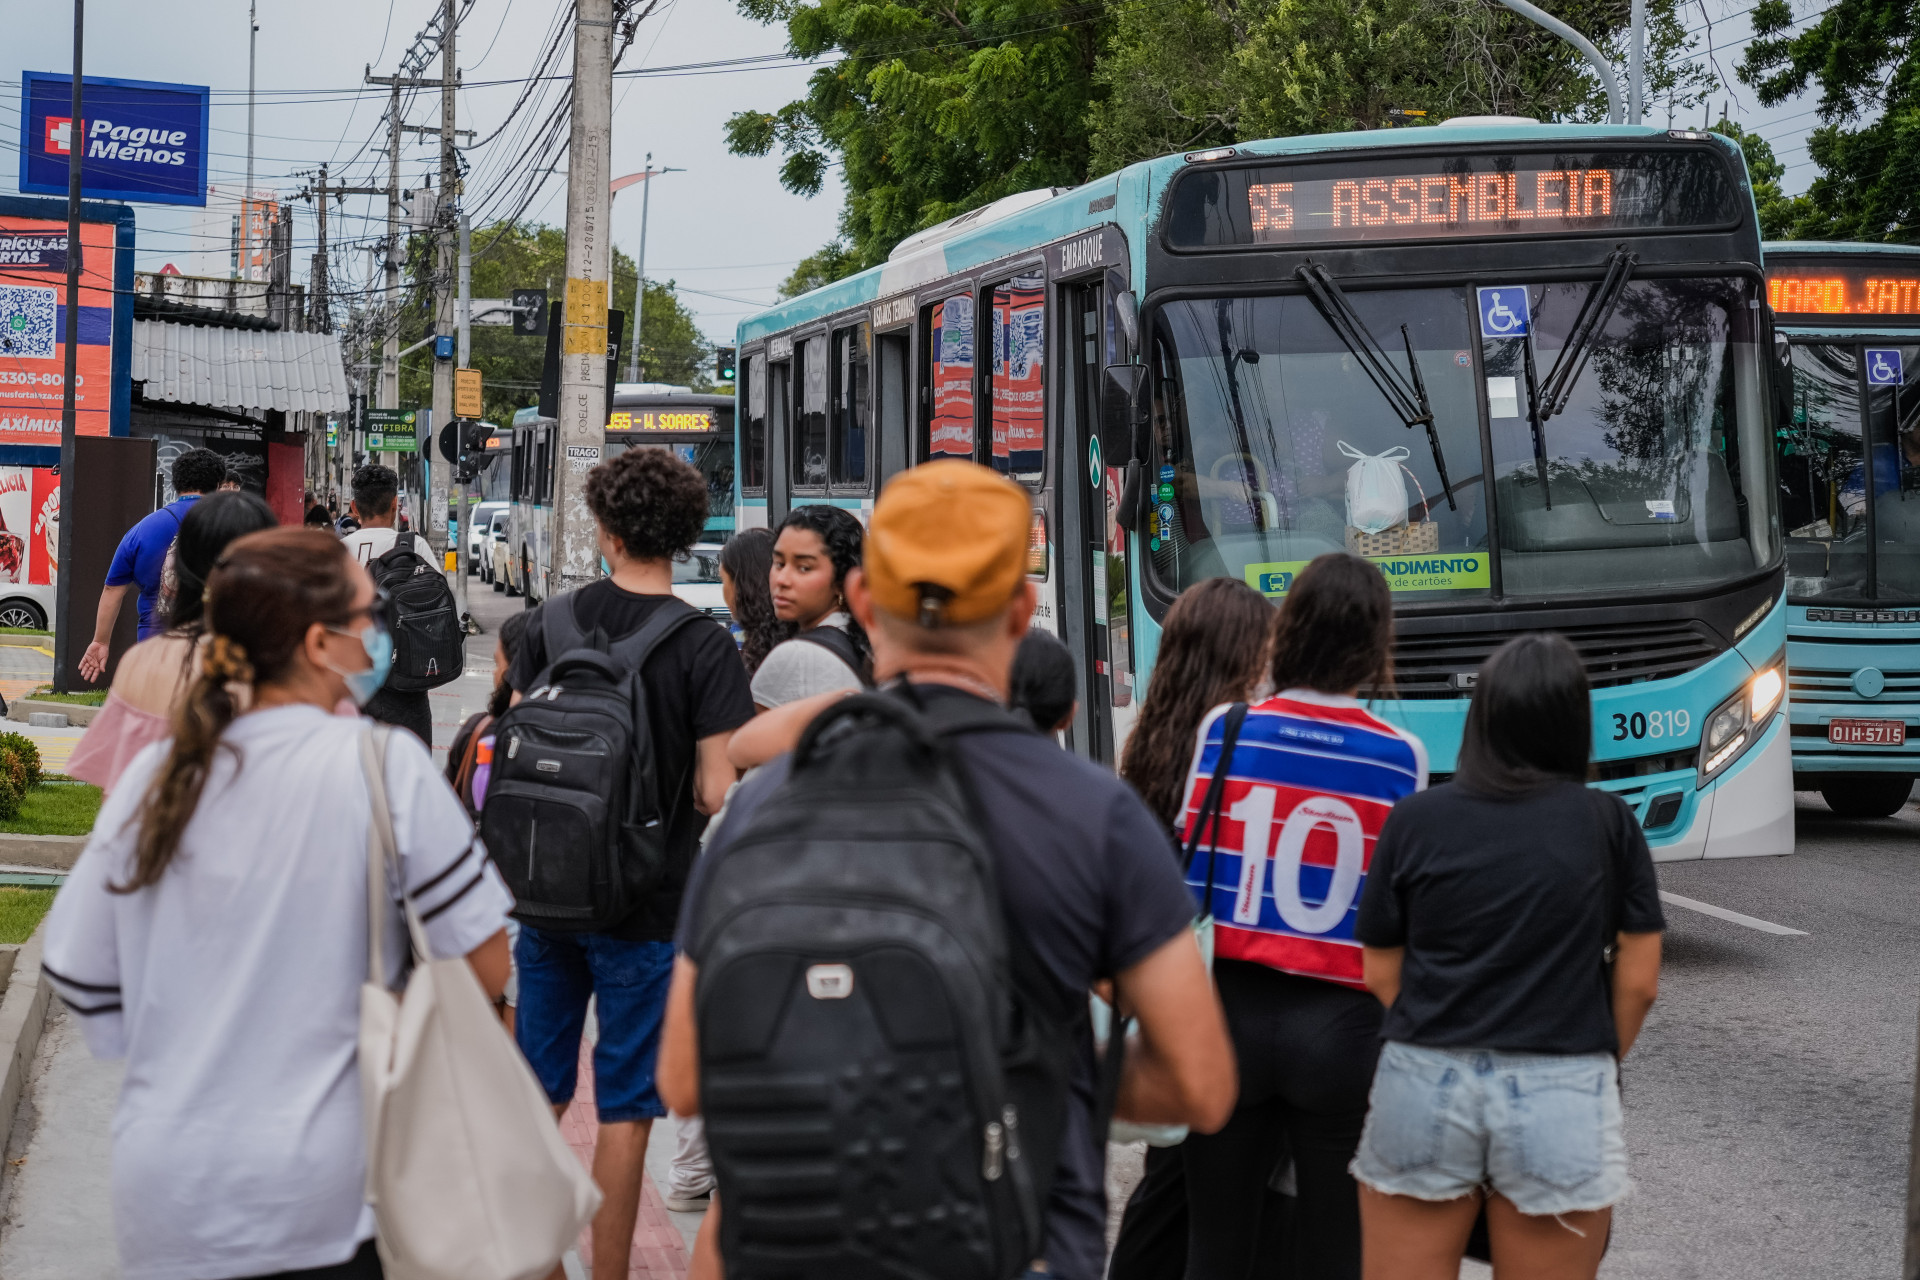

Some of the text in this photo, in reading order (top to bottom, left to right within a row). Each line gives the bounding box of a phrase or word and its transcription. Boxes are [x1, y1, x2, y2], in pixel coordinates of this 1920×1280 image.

[89, 120, 187, 148] Pague
[88, 140, 187, 166] Menos
[1332, 168, 1612, 228] ASSEMBLEIA
[1062, 233, 1102, 272] EMBARQUE
[1857, 280, 1920, 312] JAT
[0, 372, 84, 387] 3305-800
[578, 394, 588, 434] COELCE
[659, 413, 710, 430] SOARES
[569, 448, 597, 457] TRAGO
[1394, 578, 1408, 587] de
[1412, 576, 1452, 586] cartões
[1806, 608, 1920, 623] NEOBU
[1612, 709, 1690, 740] 30819
[1230, 785, 1364, 934] 10
